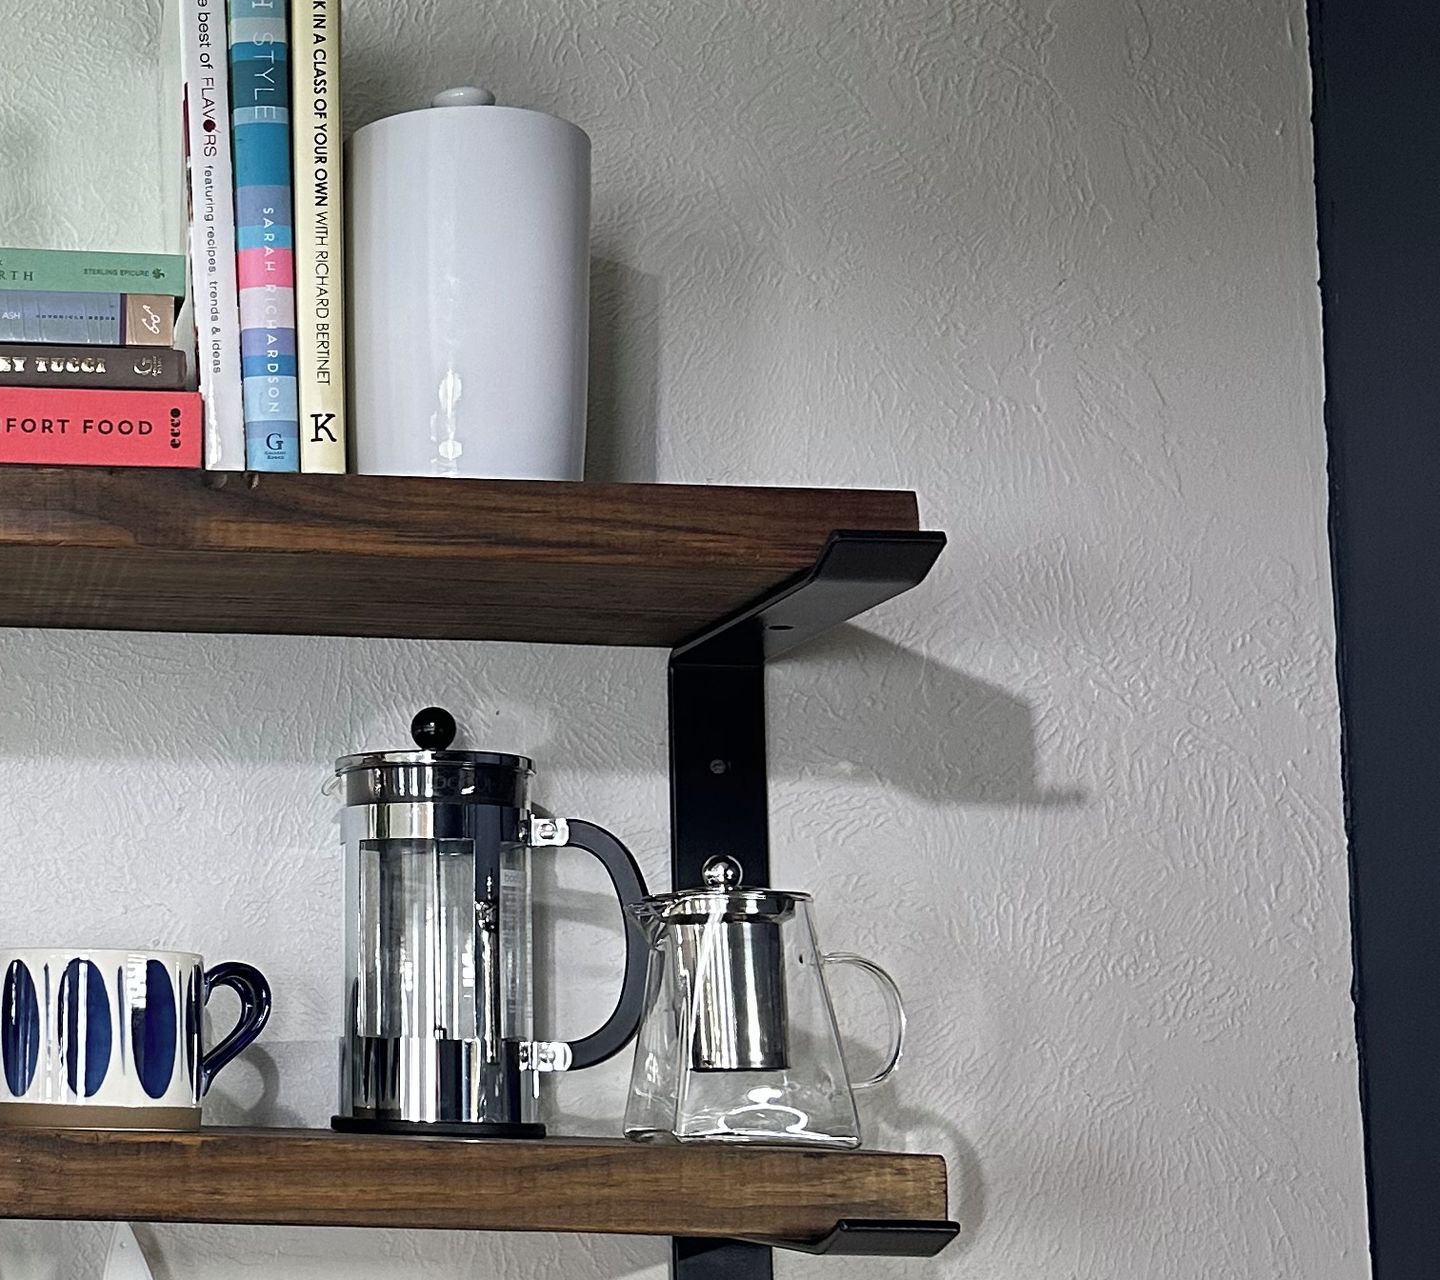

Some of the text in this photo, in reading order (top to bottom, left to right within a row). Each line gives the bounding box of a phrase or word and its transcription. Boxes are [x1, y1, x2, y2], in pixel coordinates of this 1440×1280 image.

[198, 12, 212, 48] best
[312, 14, 327, 29] IN
[312, 33, 327, 45] A
[199, 53, 214, 70] of
[252, 31, 276, 120] STYLE
[313, 48, 327, 95] CLASS
[313, 98, 328, 119] OF
[313, 123, 328, 165] YOUR
[204, 165, 215, 222] featuring
[314, 168, 329, 207] OWN
[314, 211, 329, 246] WITH
[209, 280, 220, 322] trends
[314, 250, 330, 319] RICHARD
[1, 311, 21, 320] ASH
[263, 207, 280, 413] SARAH RICHARDSON
[211, 327, 221, 336] &
[35, 356, 107, 374] TUCCI
[211, 339, 223, 374] ideas
[315, 323, 331, 386] BERTINET
[82, 419, 153, 435] FOOD
[169, 407, 182, 449] ecco
[266, 432, 284, 451] G
[309, 413, 338, 443] K
